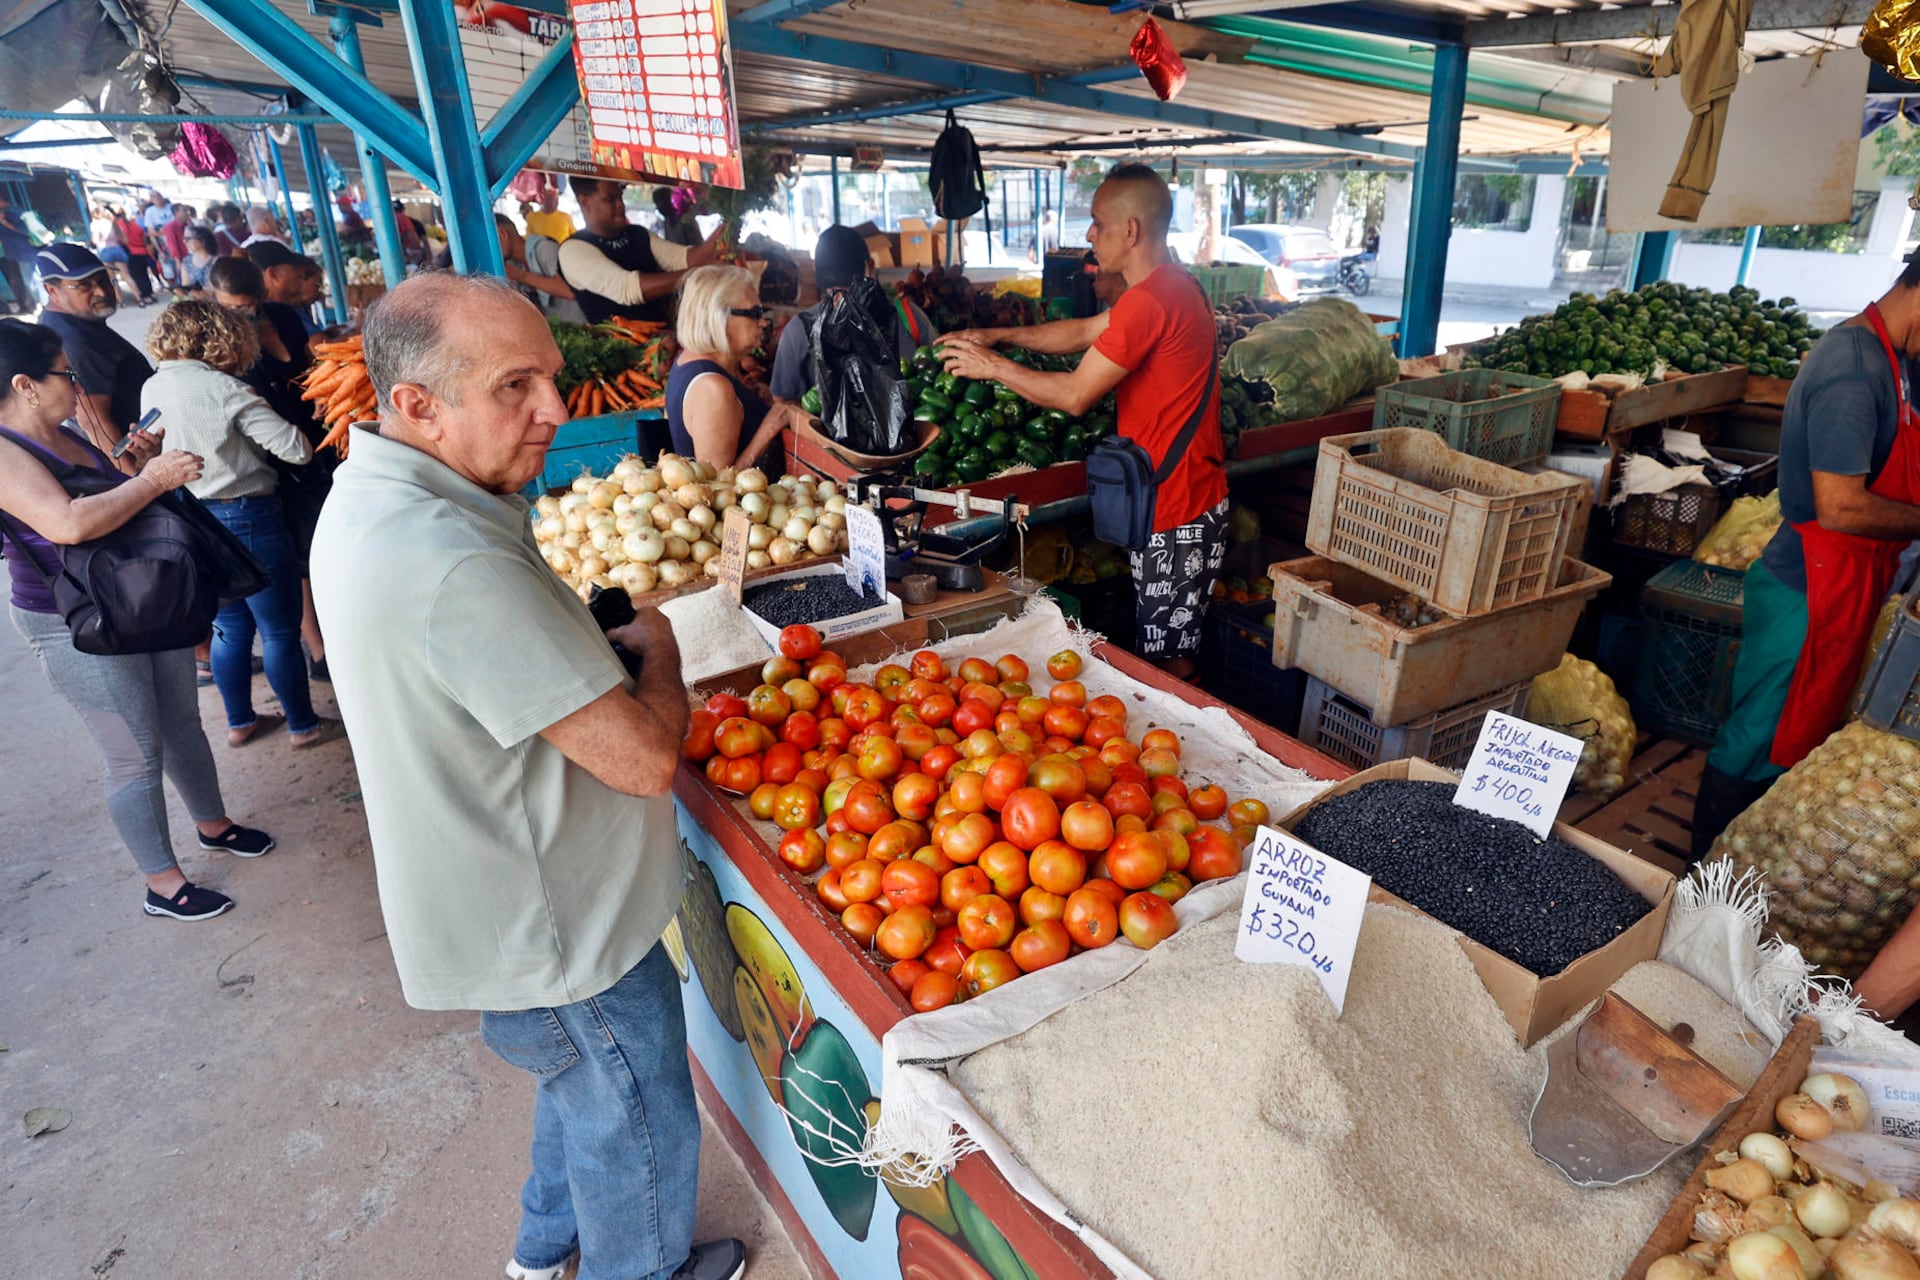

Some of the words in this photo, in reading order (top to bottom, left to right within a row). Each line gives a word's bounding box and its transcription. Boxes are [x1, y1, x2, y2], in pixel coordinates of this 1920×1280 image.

[1484, 742, 1551, 771] IMPORTADO
[1537, 739, 1579, 763] NEGRO
[1486, 756, 1549, 784] ARGENTINA
[1256, 836, 1327, 885] ARROZ
[1255, 862, 1331, 906] IMPORTADO
[1261, 881, 1316, 920] GUYANA
